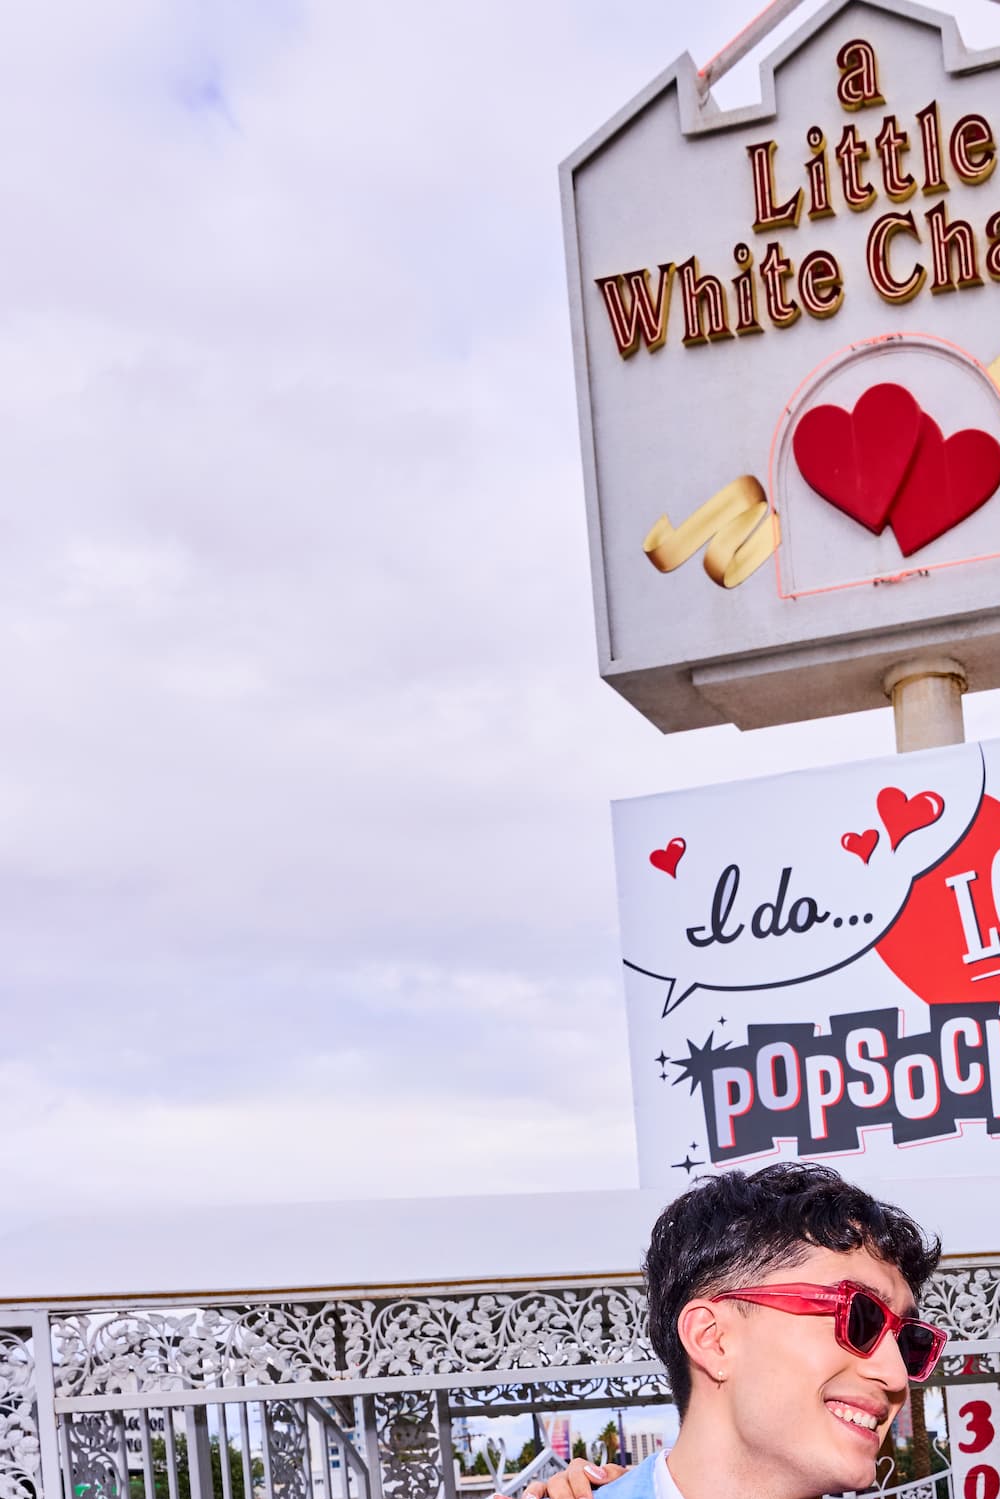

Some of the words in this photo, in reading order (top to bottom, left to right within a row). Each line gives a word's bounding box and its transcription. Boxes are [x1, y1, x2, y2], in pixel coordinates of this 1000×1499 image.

[836, 38, 886, 111] a
[746, 101, 997, 232] Little
[595, 242, 845, 360] White
[752, 867, 874, 939] do...
